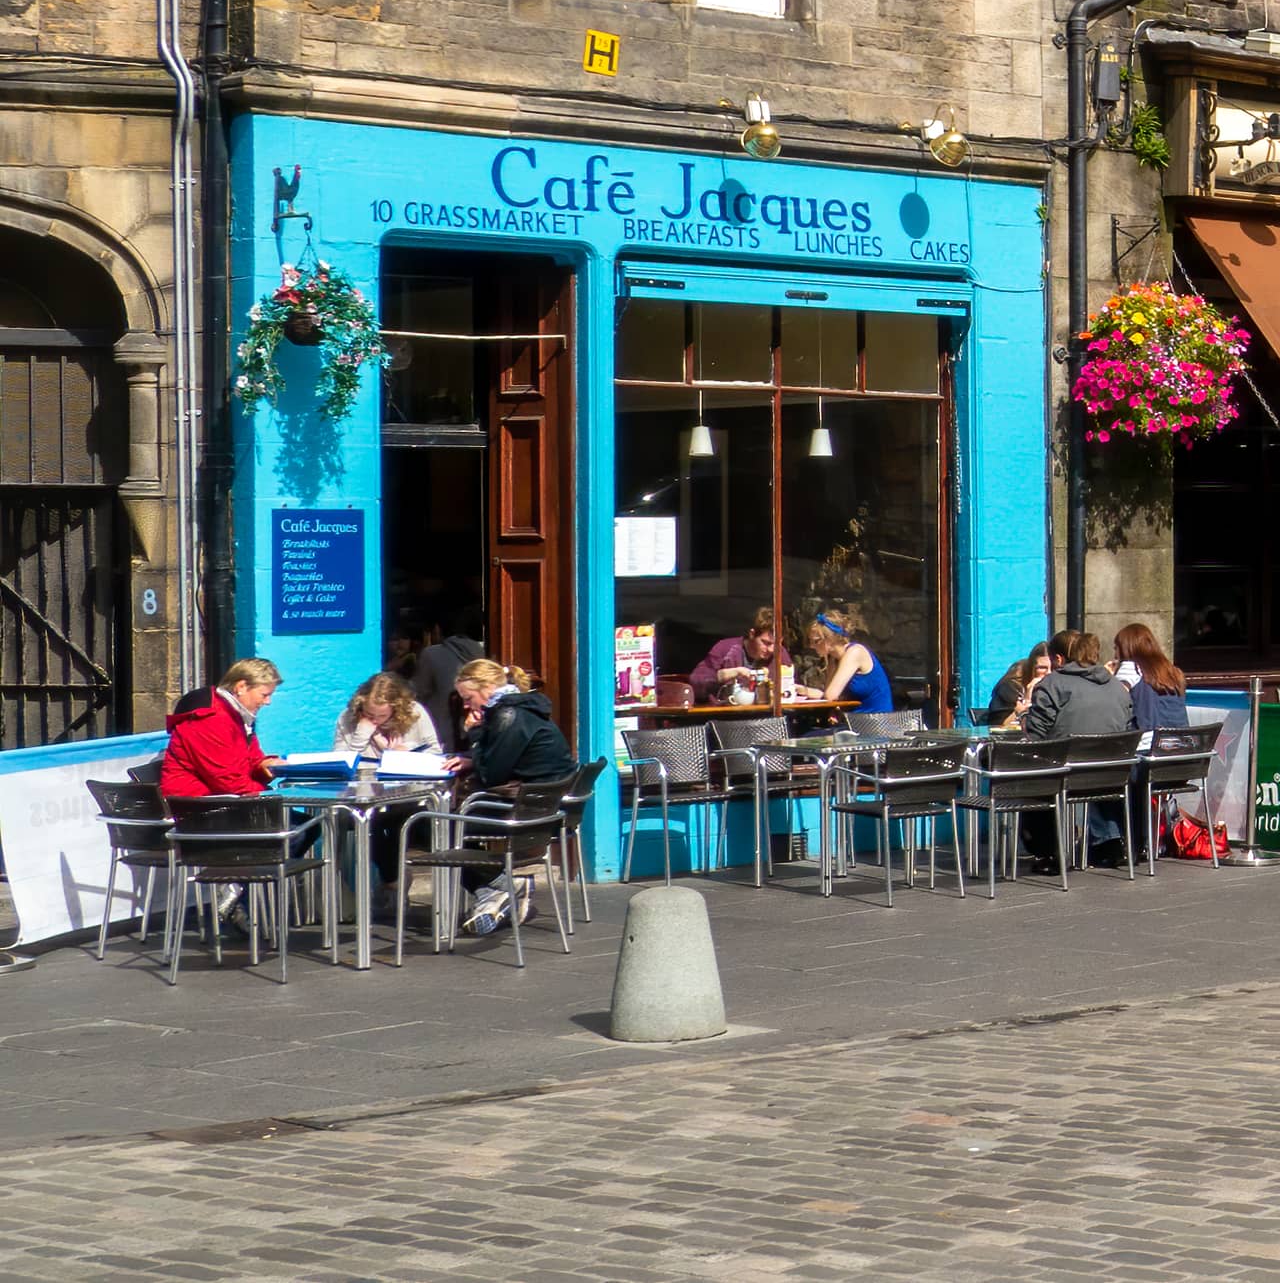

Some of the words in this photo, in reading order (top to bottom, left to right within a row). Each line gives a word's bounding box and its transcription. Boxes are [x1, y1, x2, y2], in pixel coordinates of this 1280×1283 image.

[661, 162, 872, 234] Jacques
[370, 200, 393, 222] 10
[404, 201, 584, 235] GRASSMARKET
[623, 218, 761, 249] BREAKFASTS
[794, 231, 883, 257] LUNCHES
[910, 239, 970, 263] CAKES
[312, 518, 358, 535] Jacques
[143, 588, 157, 615] 8
